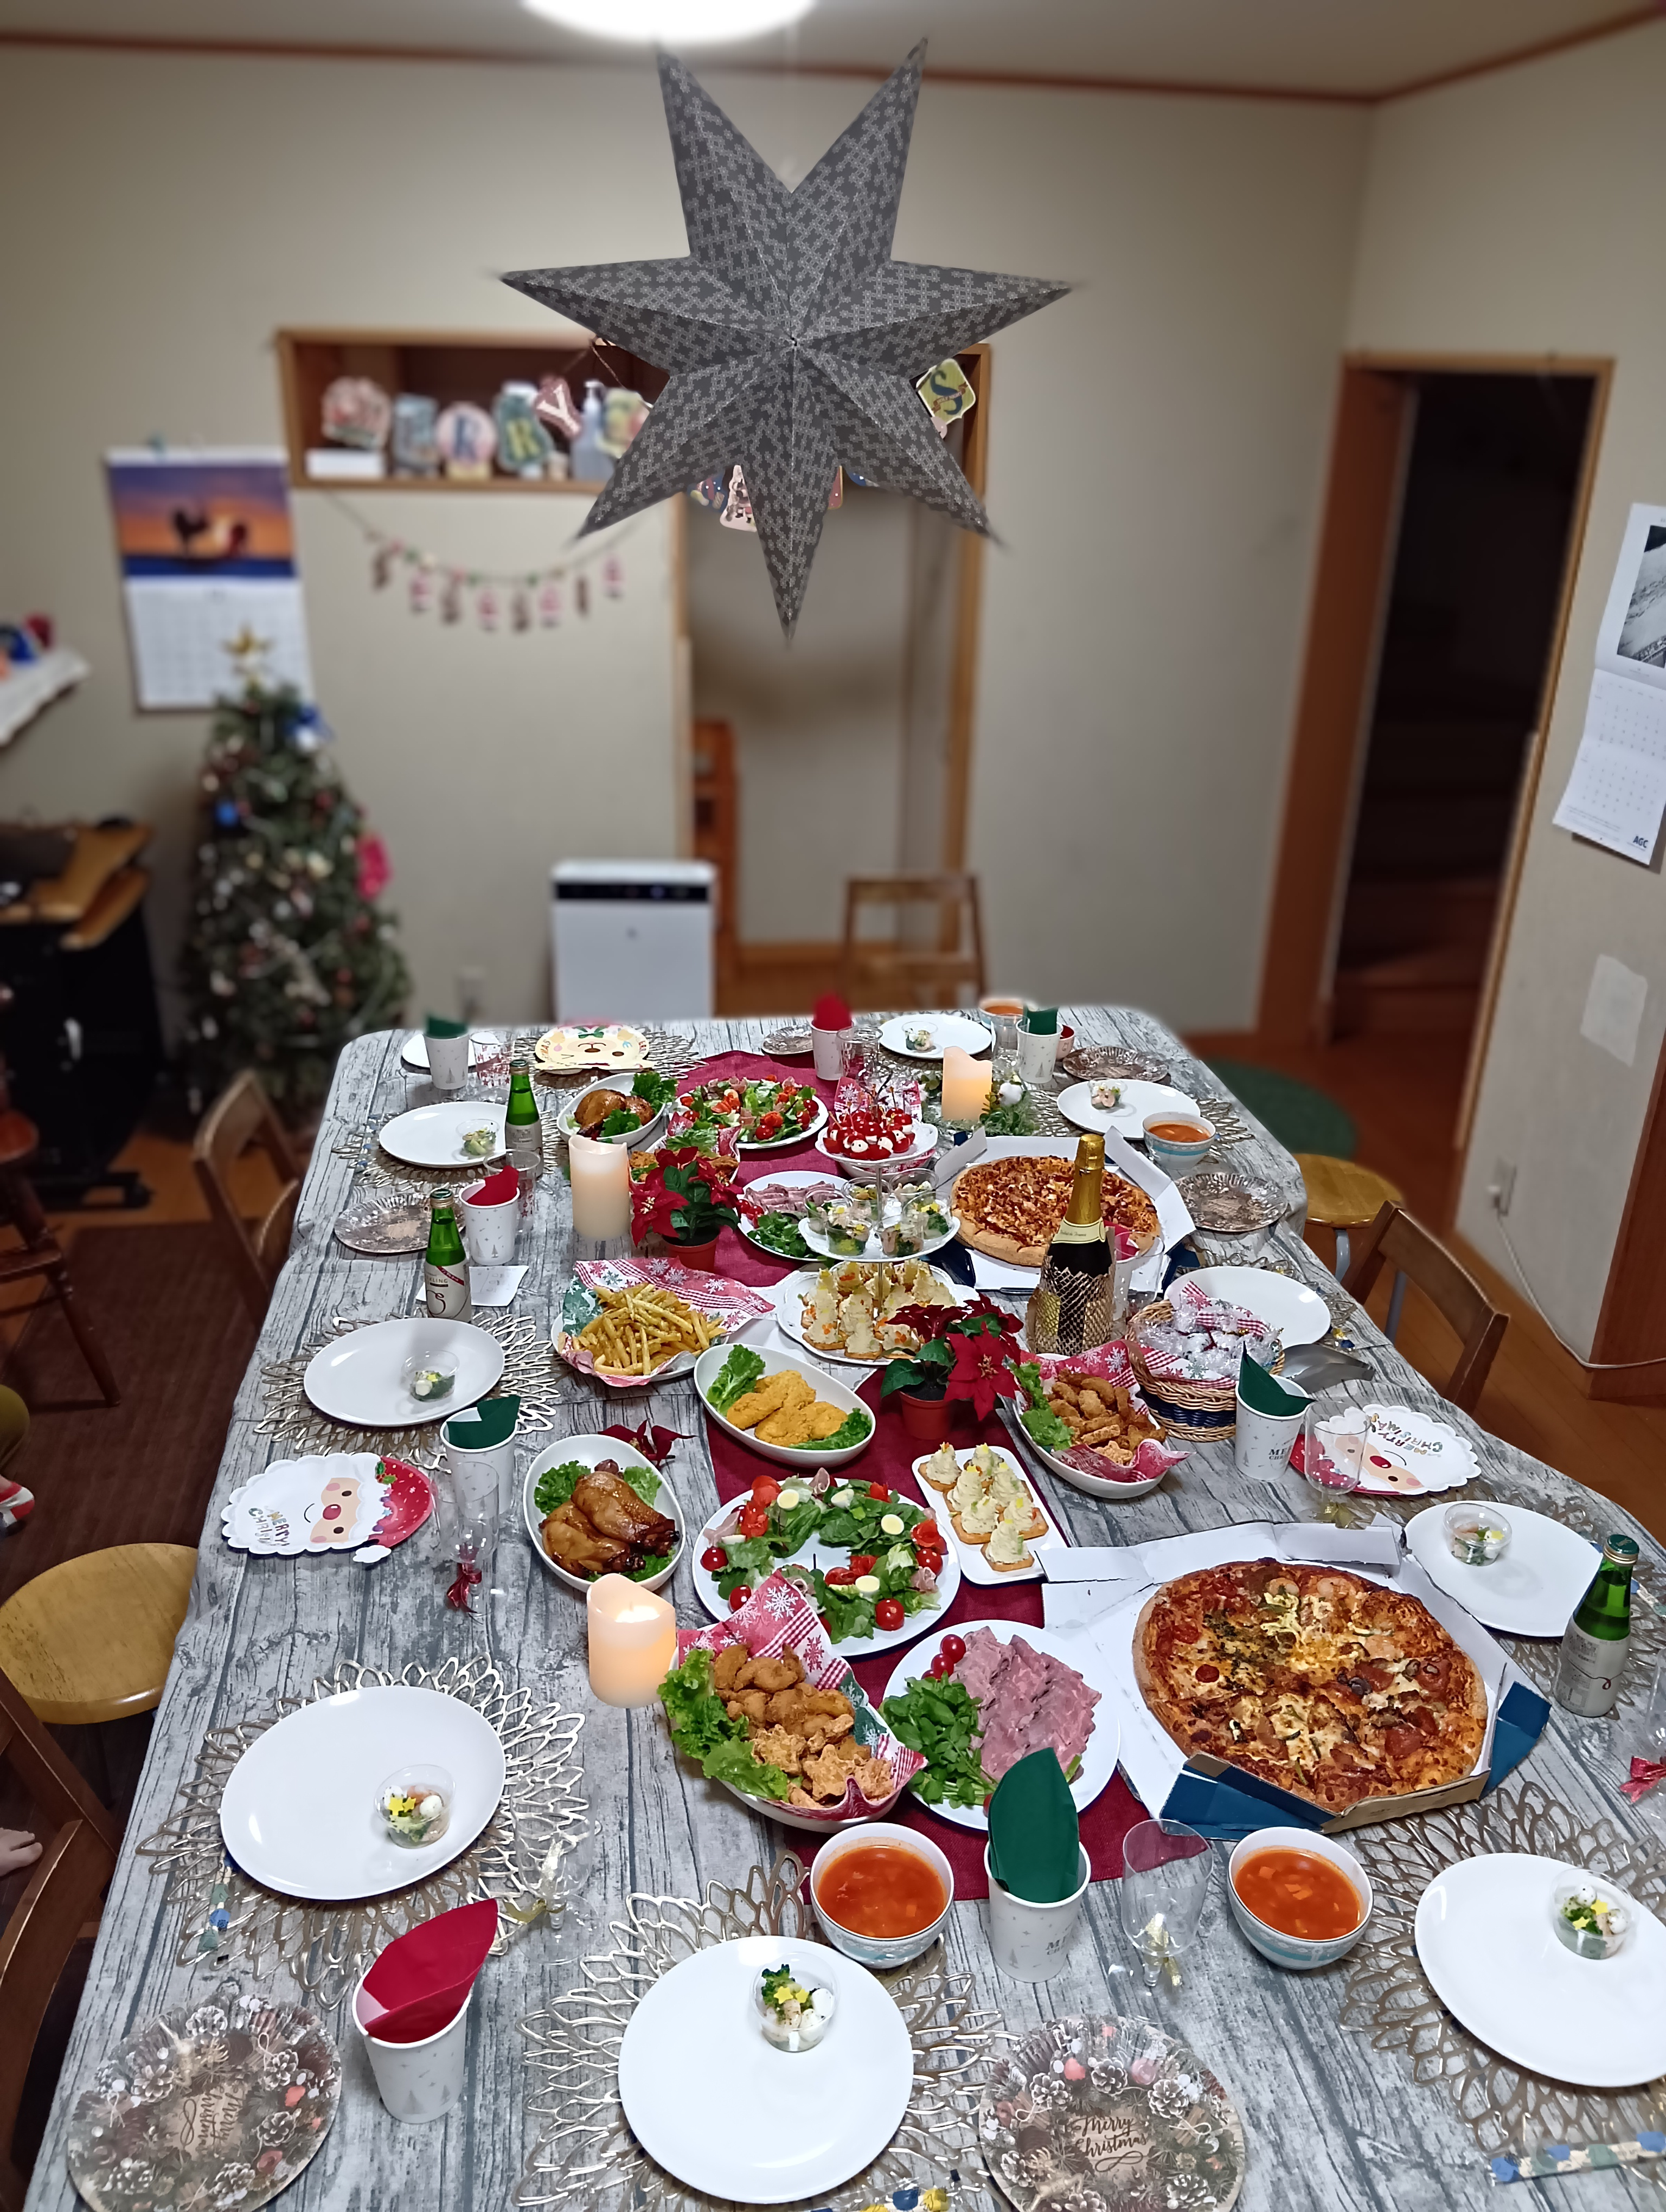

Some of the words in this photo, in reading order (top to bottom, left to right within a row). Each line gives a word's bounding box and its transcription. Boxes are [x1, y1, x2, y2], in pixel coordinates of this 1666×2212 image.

[1633, 835, 1649, 848] AGC
[1068, 2116, 1138, 2139] Merry
[1075, 2133, 1147, 2157] Christmas
